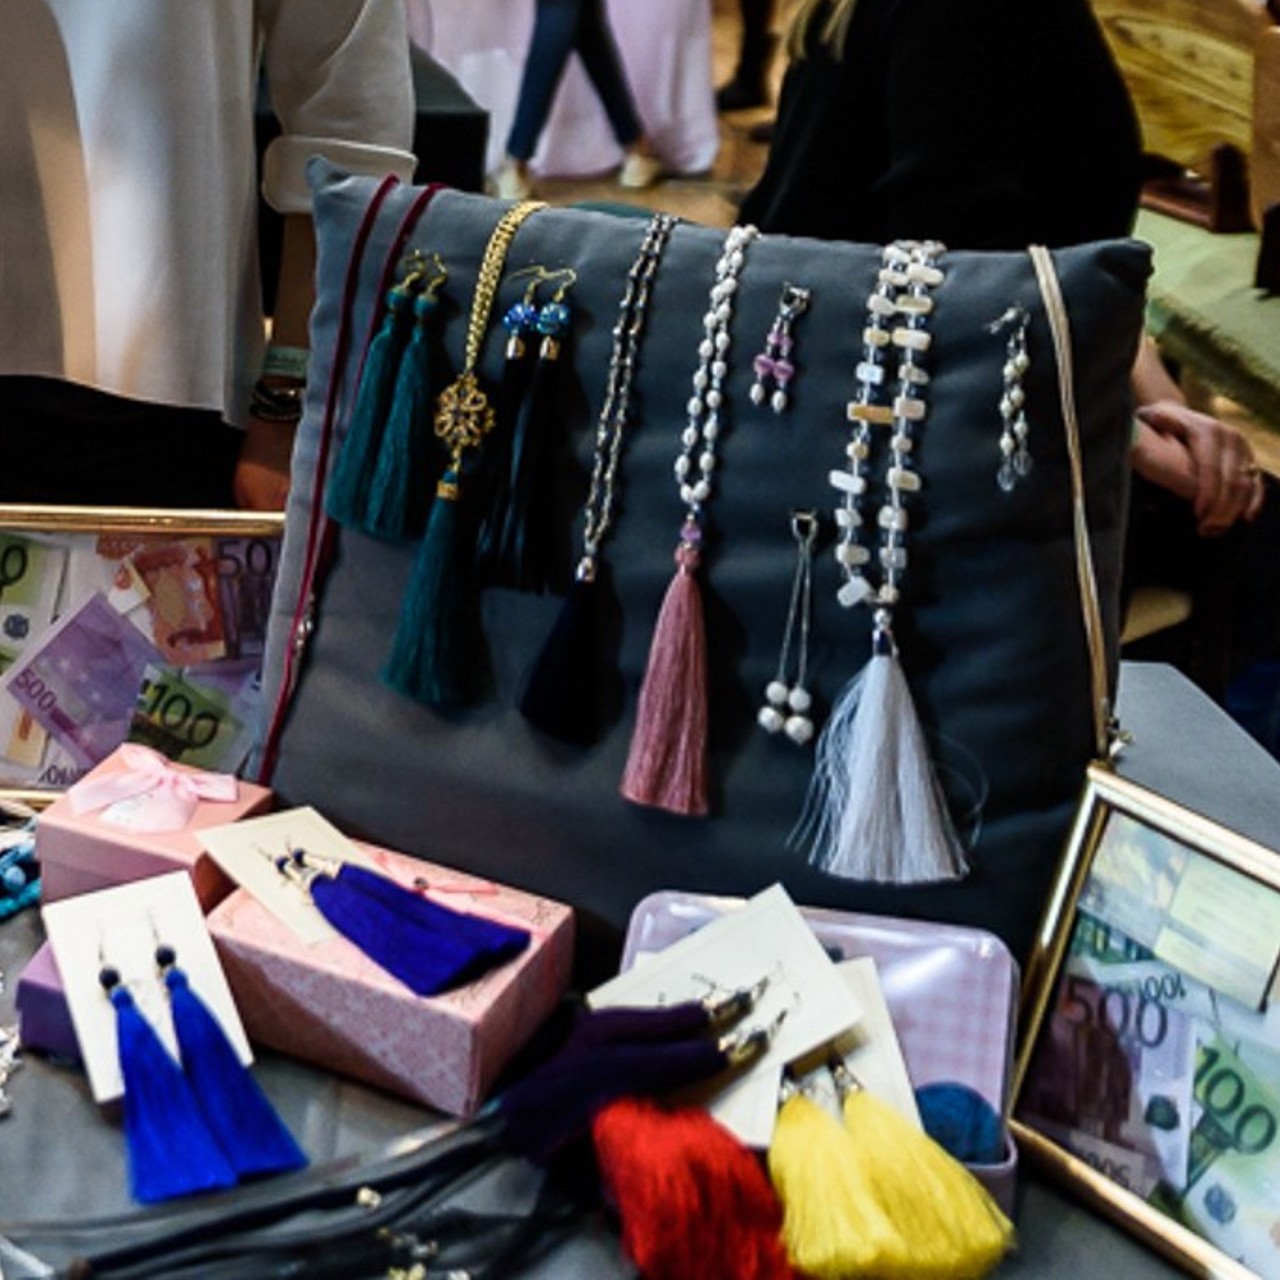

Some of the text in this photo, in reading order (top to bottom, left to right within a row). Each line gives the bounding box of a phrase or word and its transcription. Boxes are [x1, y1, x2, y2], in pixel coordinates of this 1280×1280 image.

[16, 668, 57, 712] 500
[148, 682, 219, 749] 100
[1064, 974, 1168, 1048] 500
[1193, 1045, 1277, 1155] 100
